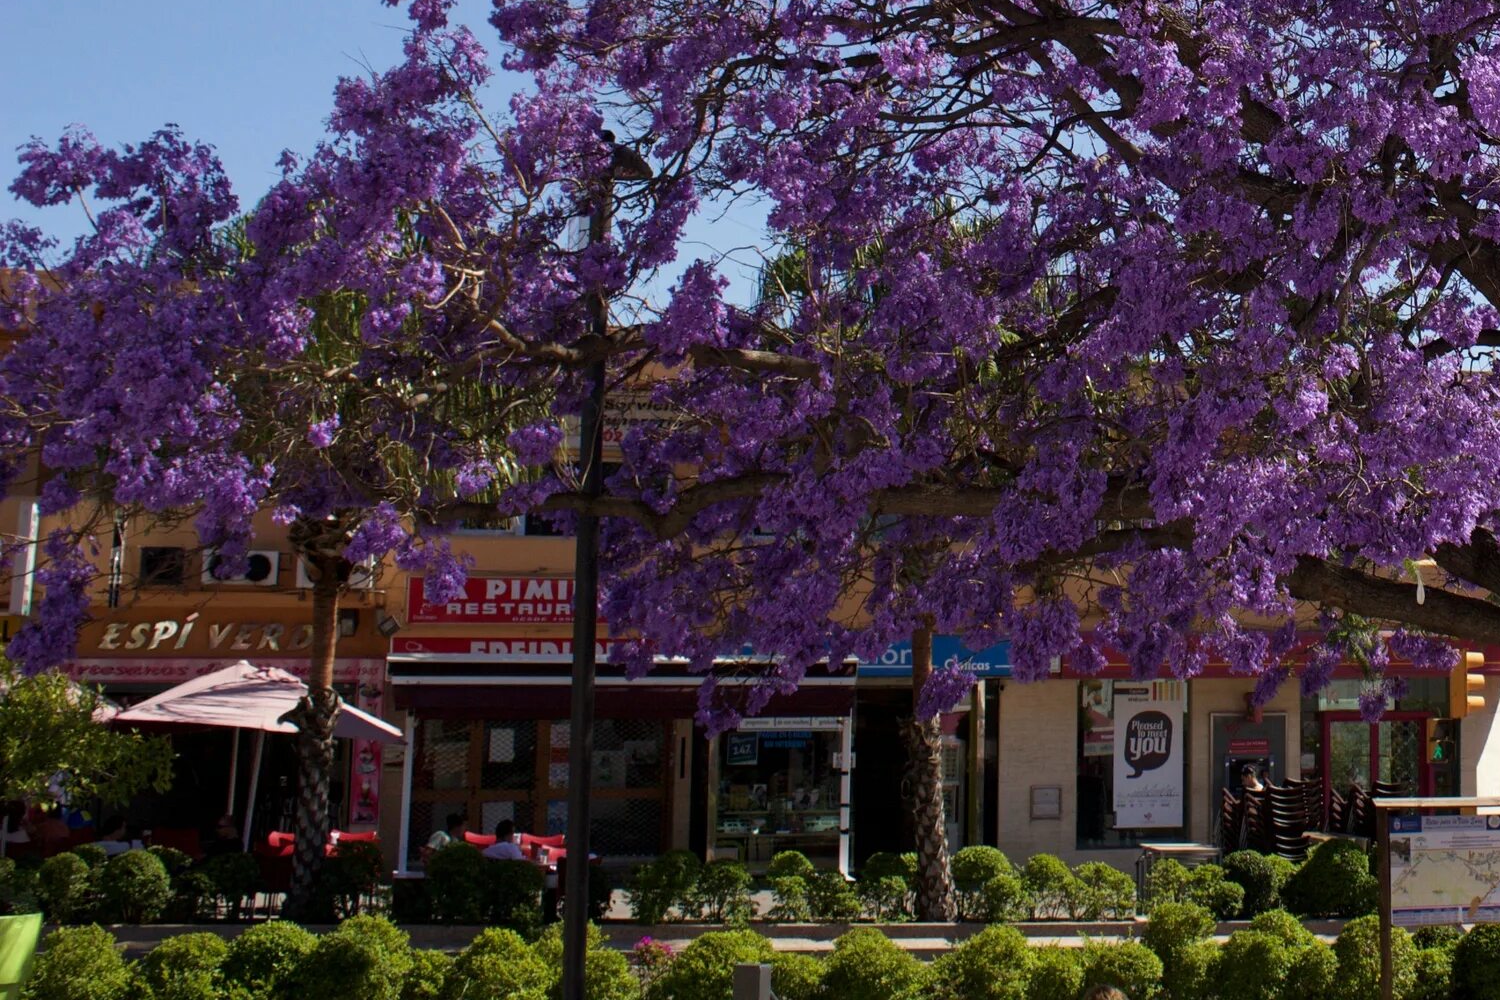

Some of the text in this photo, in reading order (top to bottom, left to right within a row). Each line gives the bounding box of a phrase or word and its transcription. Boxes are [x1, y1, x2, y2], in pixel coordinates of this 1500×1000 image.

[486, 579, 577, 600] PIMI
[98, 612, 200, 650] ESPÍ
[1131, 720, 1163, 731] Pleased
[1147, 730, 1168, 738] meet
[1129, 736, 1167, 761] you
